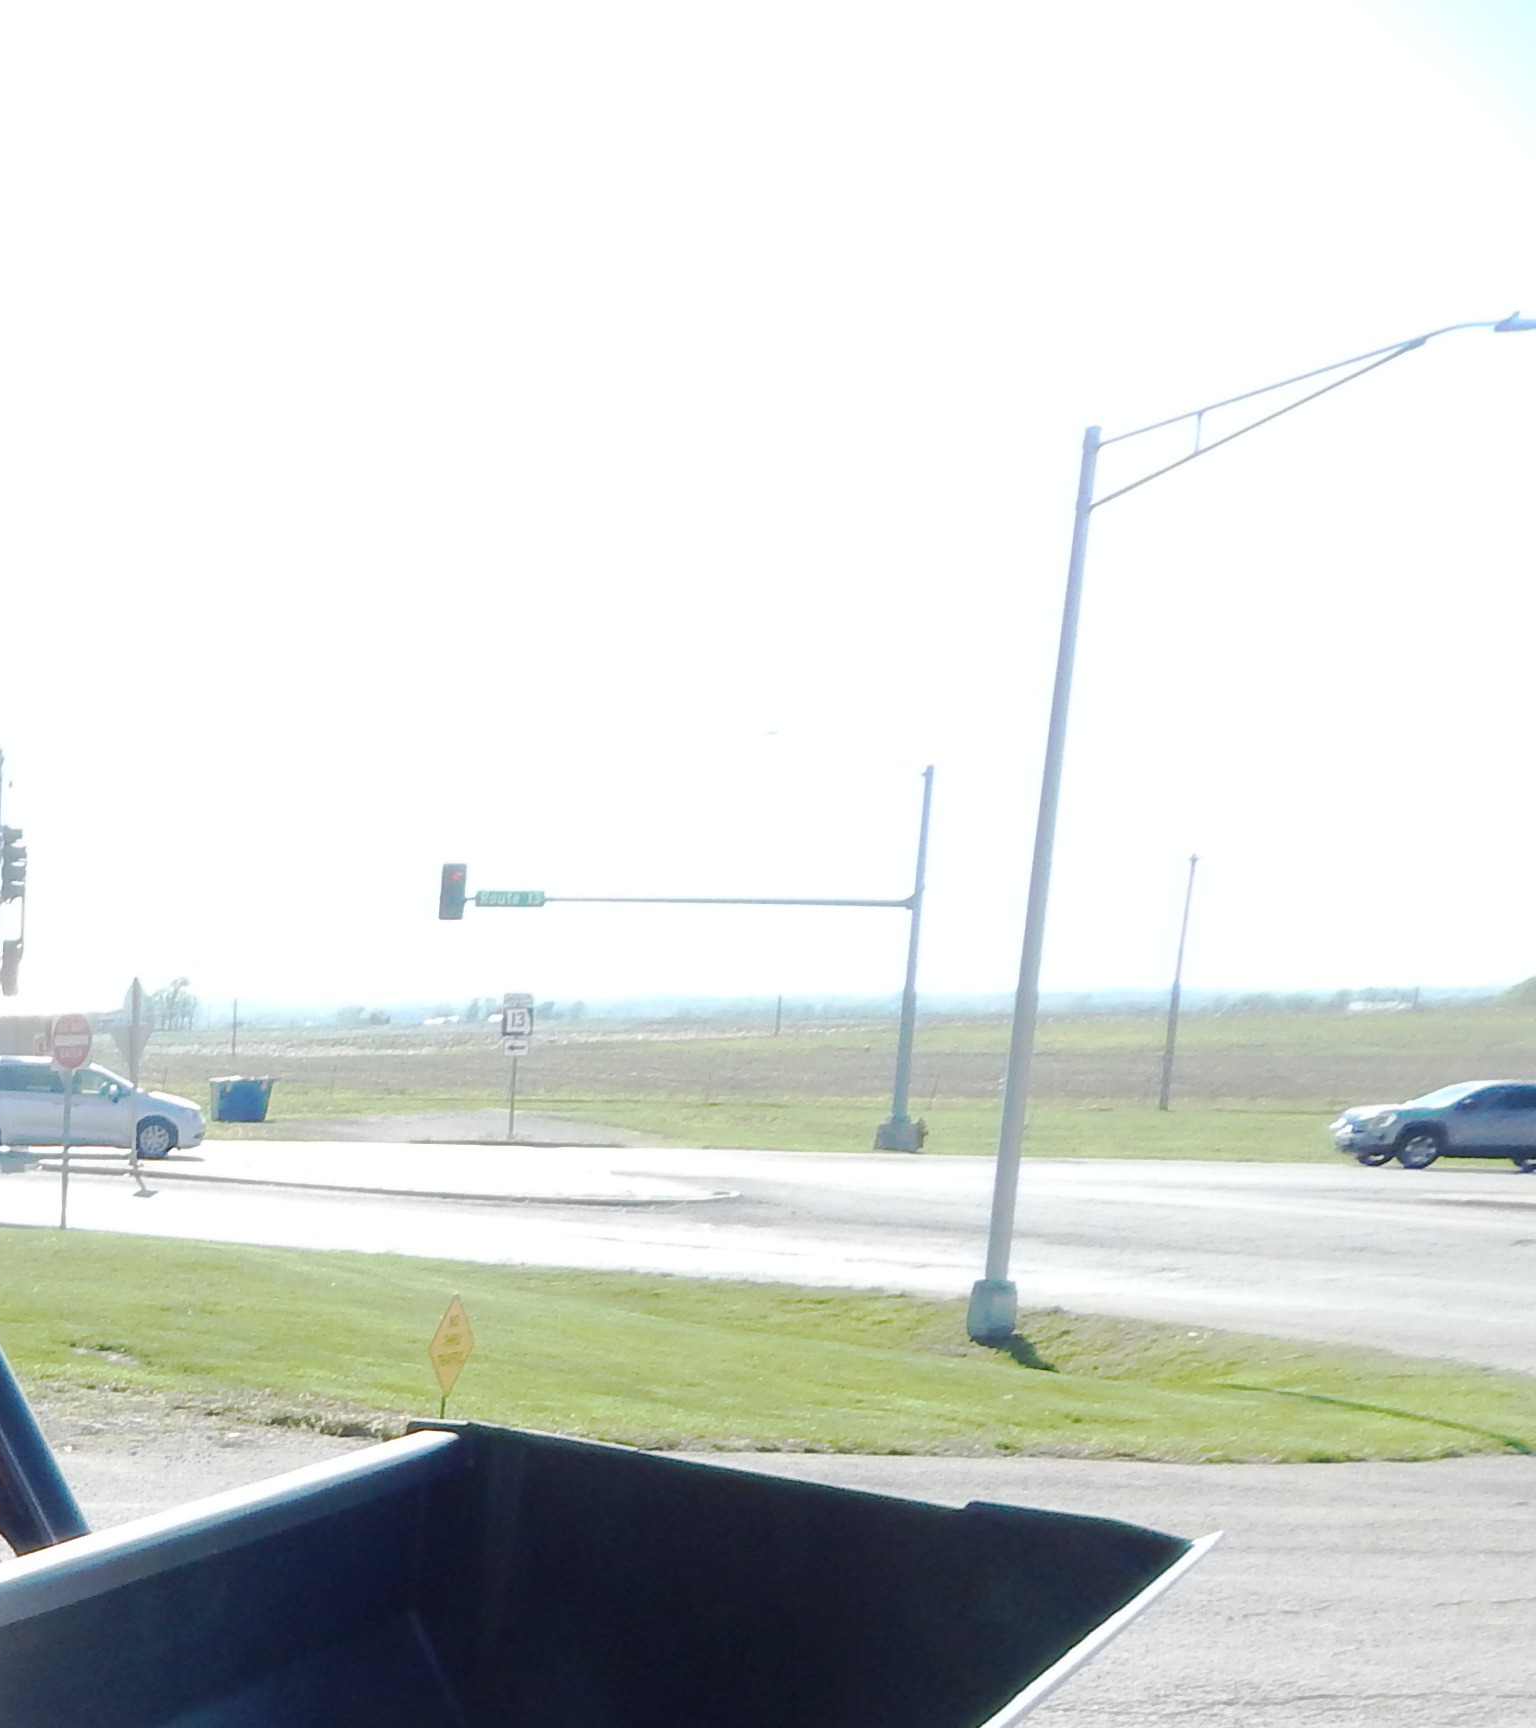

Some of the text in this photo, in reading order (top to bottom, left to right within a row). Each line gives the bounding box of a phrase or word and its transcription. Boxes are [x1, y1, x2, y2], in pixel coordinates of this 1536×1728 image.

[480, 891, 542, 905] Route 13
[511, 1011, 526, 1028] 13
